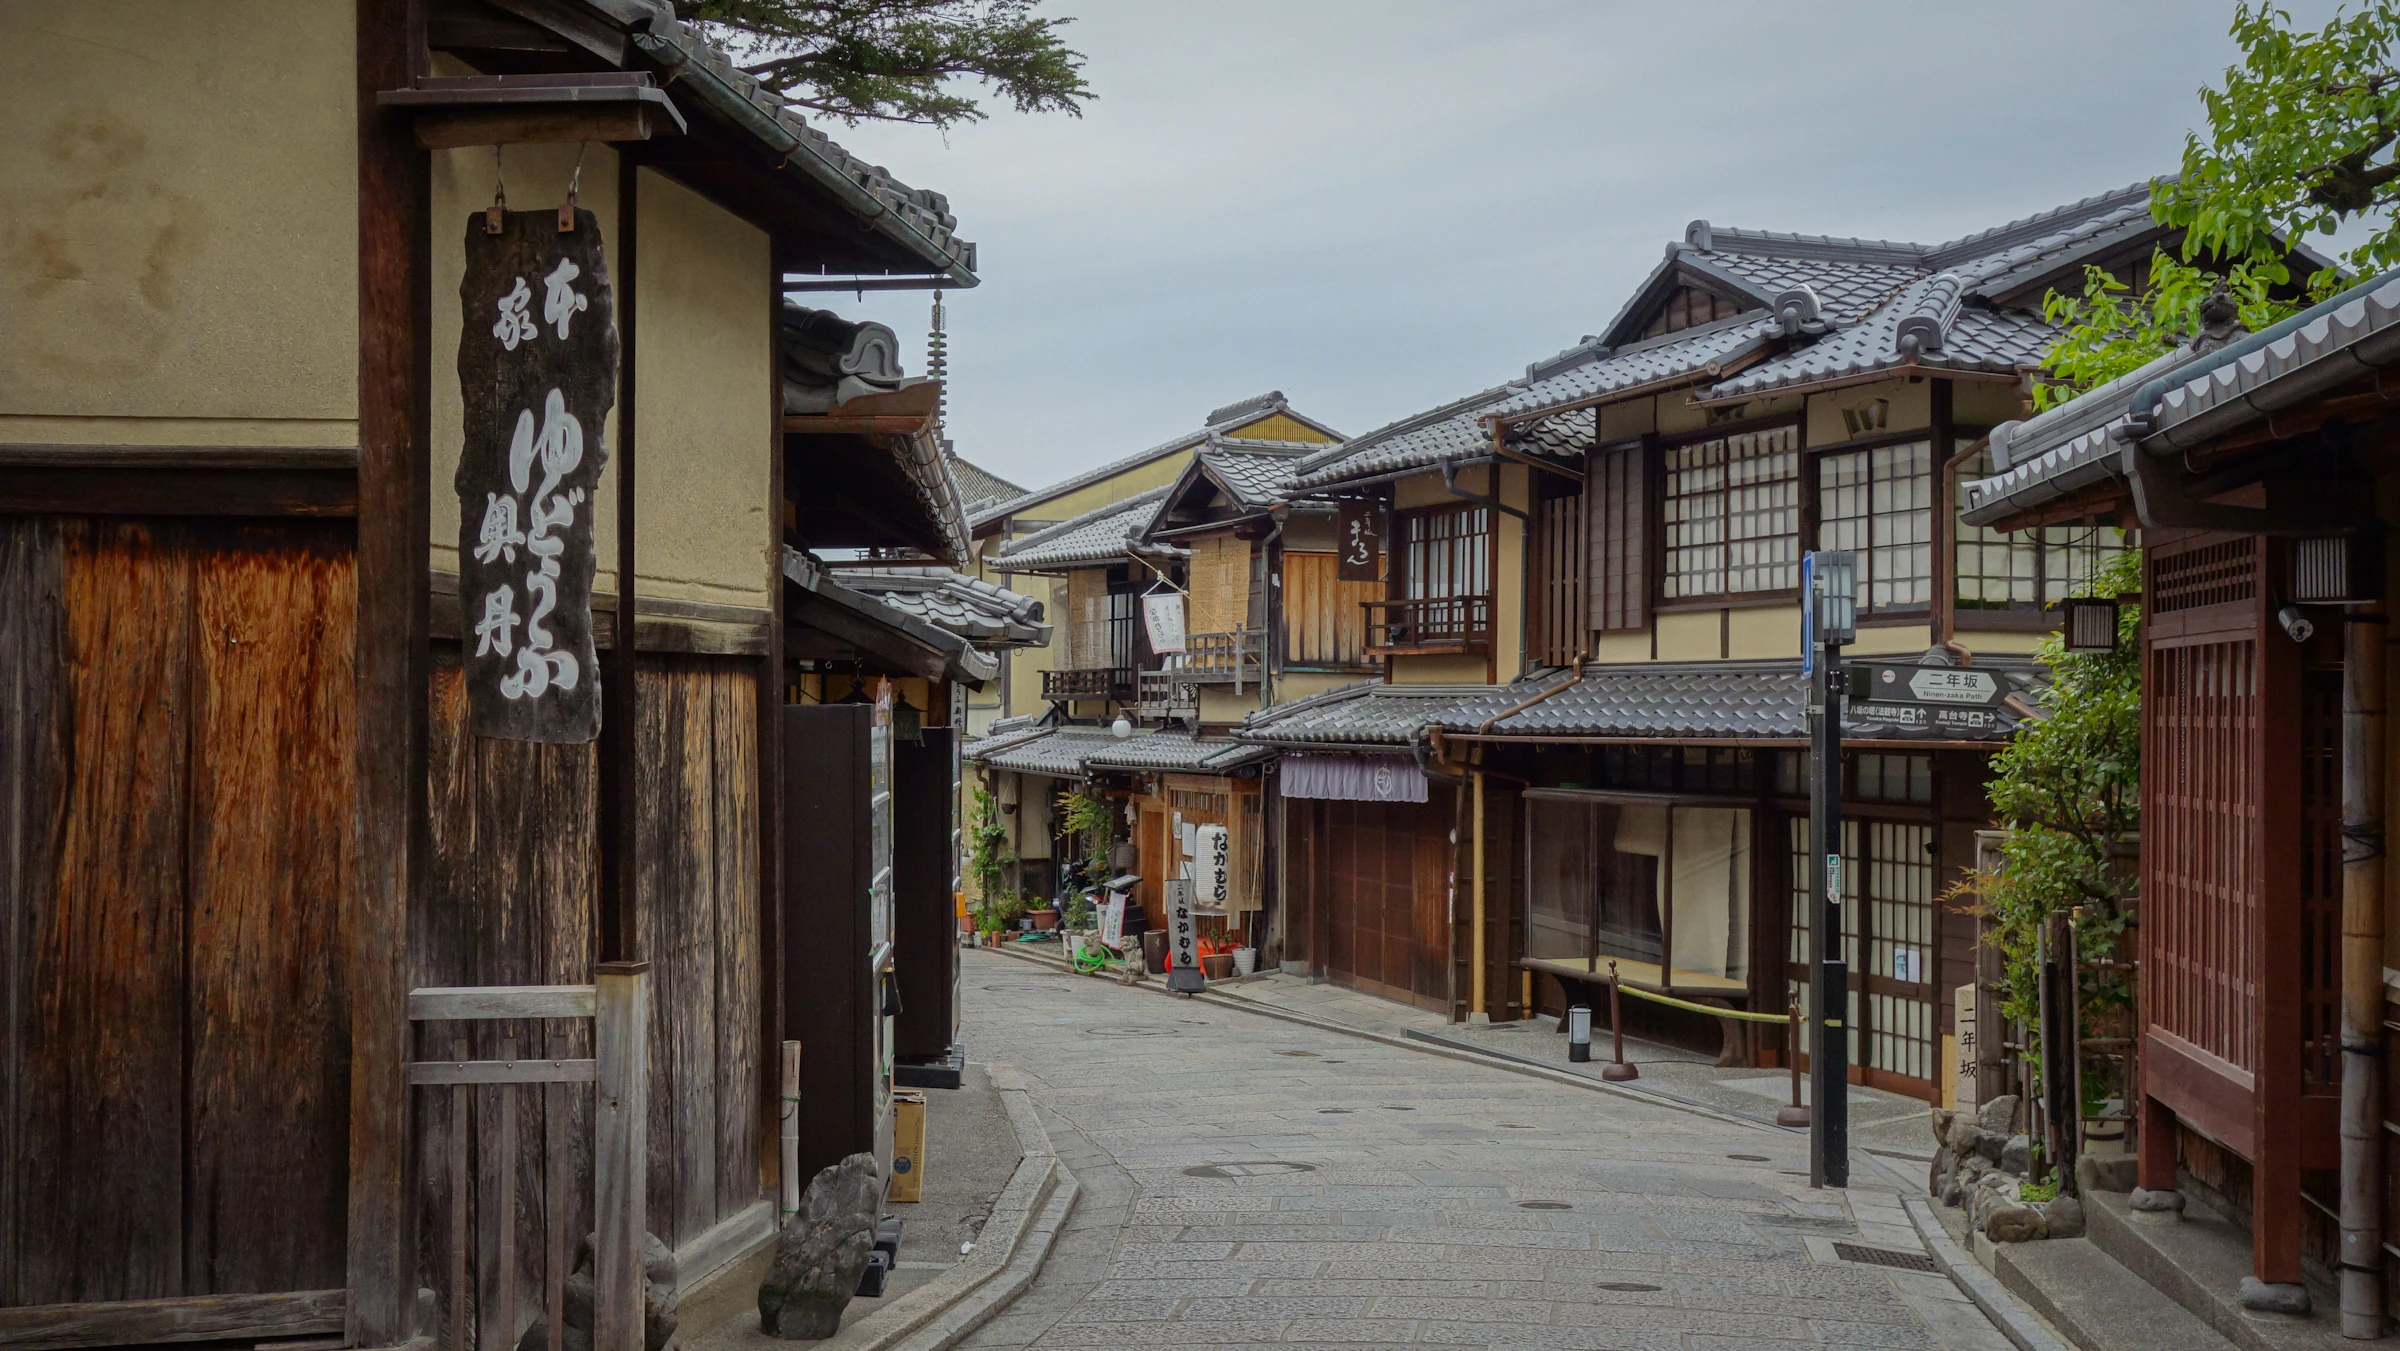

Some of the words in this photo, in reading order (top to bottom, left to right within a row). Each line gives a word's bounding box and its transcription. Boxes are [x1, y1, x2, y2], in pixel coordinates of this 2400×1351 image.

[474, 492, 526, 658] 奥丹
[1923, 690, 1964, 699] Ninen-zaka
[1965, 692, 1983, 700] Path
[1928, 673, 1979, 689] 二年坂
[1938, 710, 1968, 720] 高台寺
[1211, 831, 1229, 901] なかむら
[1176, 906, 1192, 965] なかむら
[1959, 1007, 1976, 1079] 二年坂
